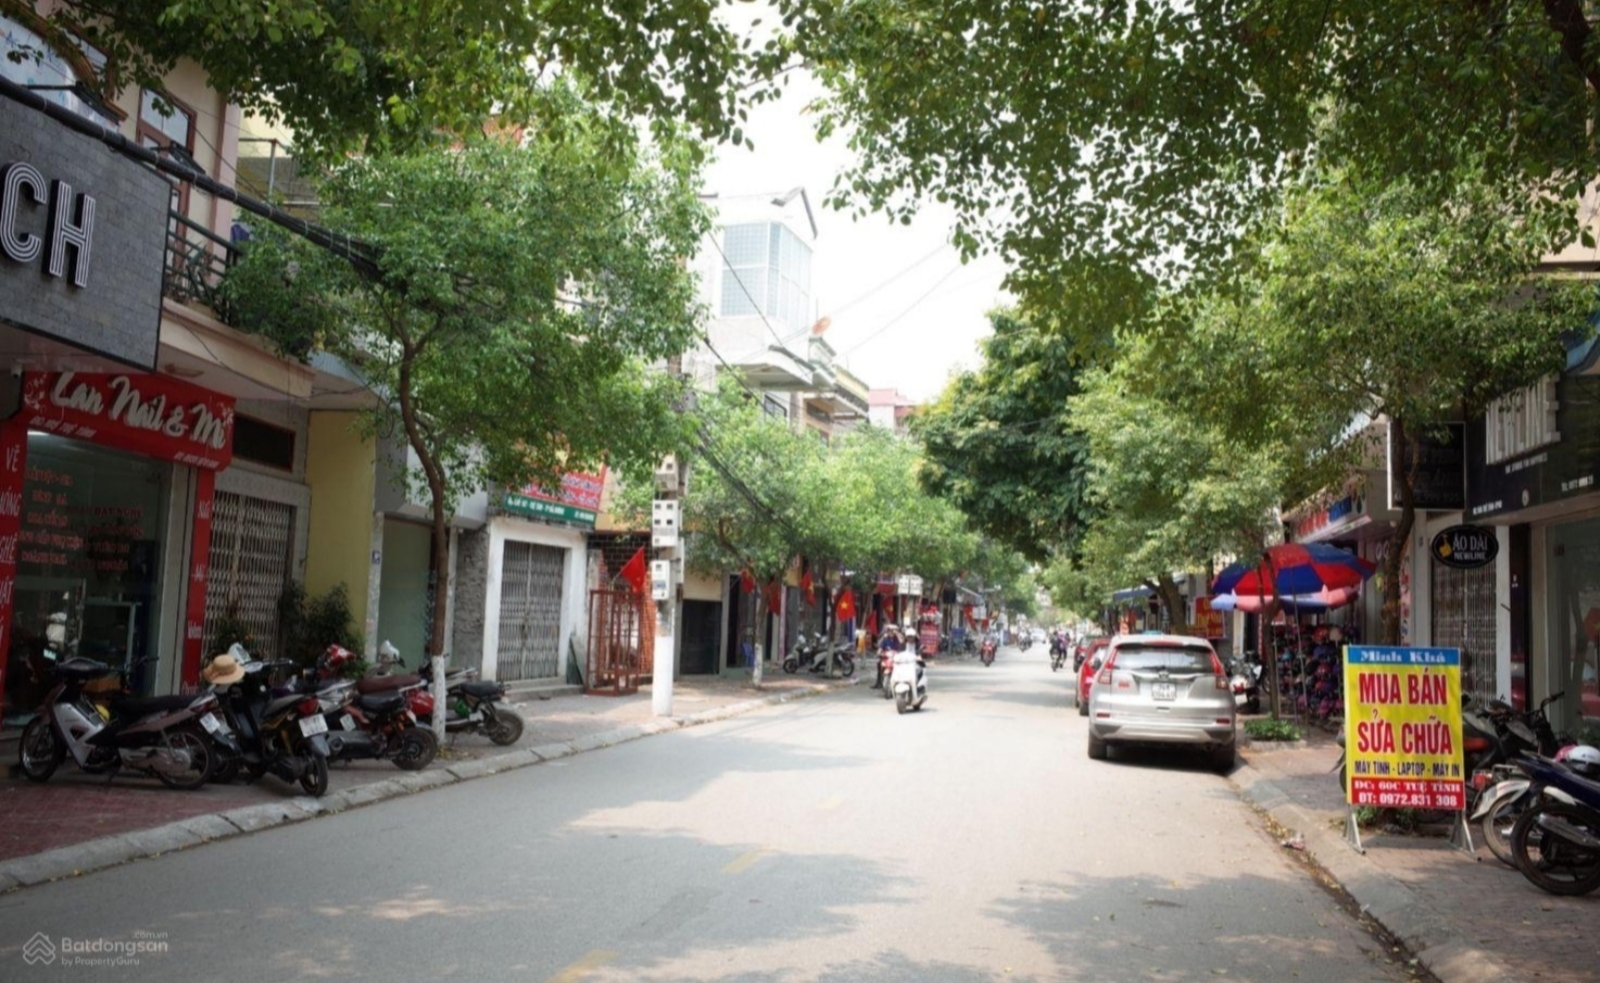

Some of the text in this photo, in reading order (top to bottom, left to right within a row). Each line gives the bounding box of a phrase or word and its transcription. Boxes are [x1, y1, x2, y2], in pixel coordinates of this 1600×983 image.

[52, 372, 104, 415] Lan
[108, 376, 166, 430] Nail
[164, 406, 189, 437] &
[188, 403, 228, 449] Mi
[1453, 532, 1488, 551] ÁO DÀI
[1360, 650, 1402, 662] Minh
[1359, 668, 1447, 705] MUA BÁN
[1357, 709, 1453, 755] SỬA CHỮA
[1398, 762, 1425, 775] LAPTOP
[1451, 763, 1460, 777] IN
[1379, 793, 1431, 806] 0972.831
[1436, 795, 1457, 807] 308
